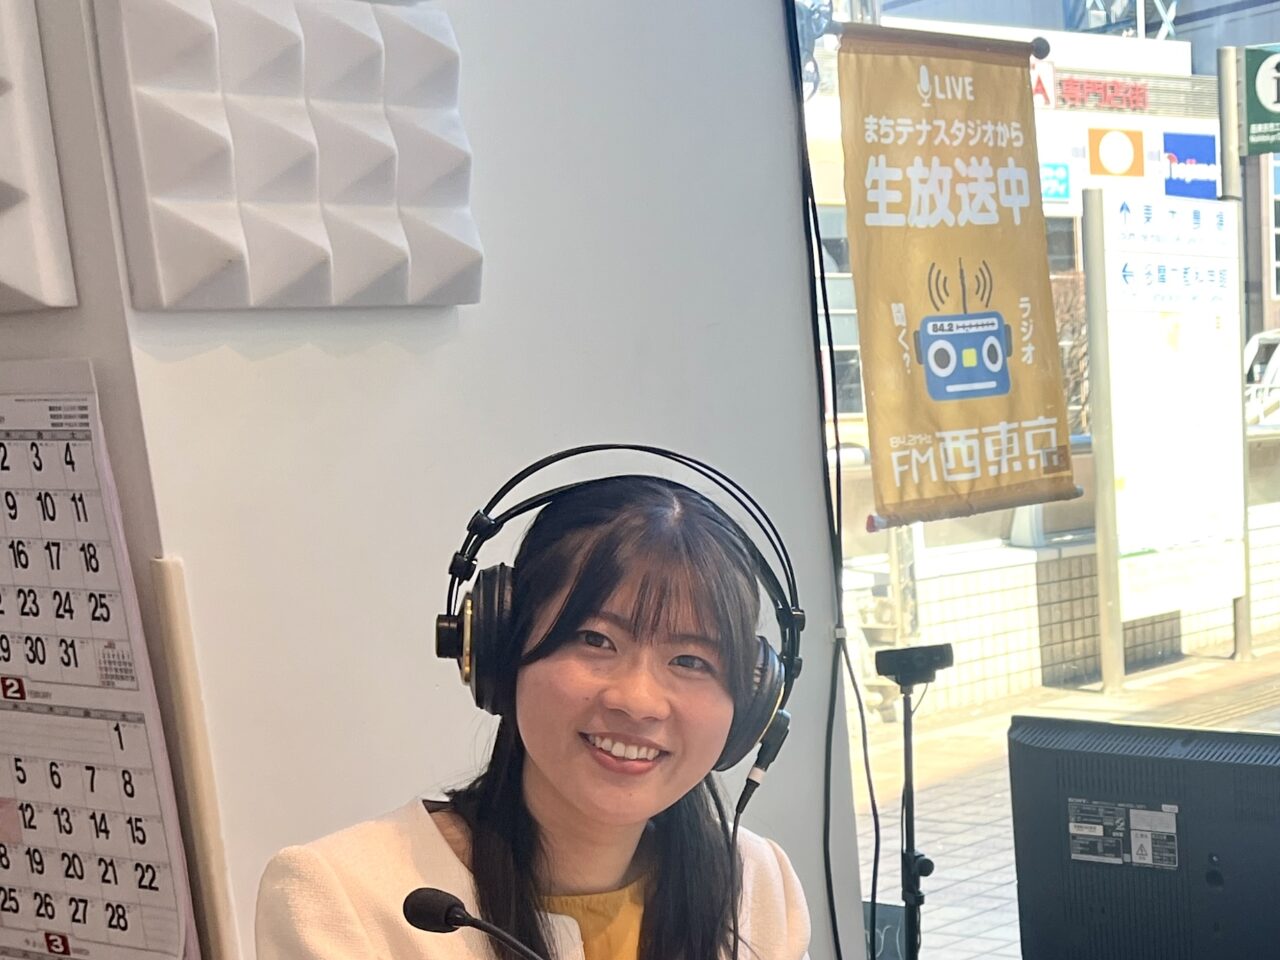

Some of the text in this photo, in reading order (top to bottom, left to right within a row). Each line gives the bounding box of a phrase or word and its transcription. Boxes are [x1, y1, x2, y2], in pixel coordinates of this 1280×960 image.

[934, 75, 975, 101] LIVE
[864, 115, 1024, 147] まちテナスタジオから
[865, 154, 1031, 228] 生放送中
[932, 322, 954, 333] 84.2
[1018, 297, 1035, 365] ラジオ
[30, 442, 43, 472] 3
[64, 442, 75, 472] 4
[4, 491, 88, 522] 9 10 11
[8, 540, 100, 573] 16 17 18
[17, 588, 111, 622] 23 24 25
[0, 634, 11, 662] 9
[24, 636, 46, 665] 30
[59, 638, 79, 668] 31
[6, 678, 21, 698] 2
[114, 722, 124, 751] 1
[14, 757, 135, 798] 5 6 7 8
[18, 803, 146, 845] 12 13 14 15
[25, 847, 45, 875] 19
[61, 852, 84, 880] 20
[98, 857, 118, 885] 21
[134, 863, 159, 891] 22
[0, 886, 128, 931] 25 26 27 28
[49, 935, 65, 953] 3
